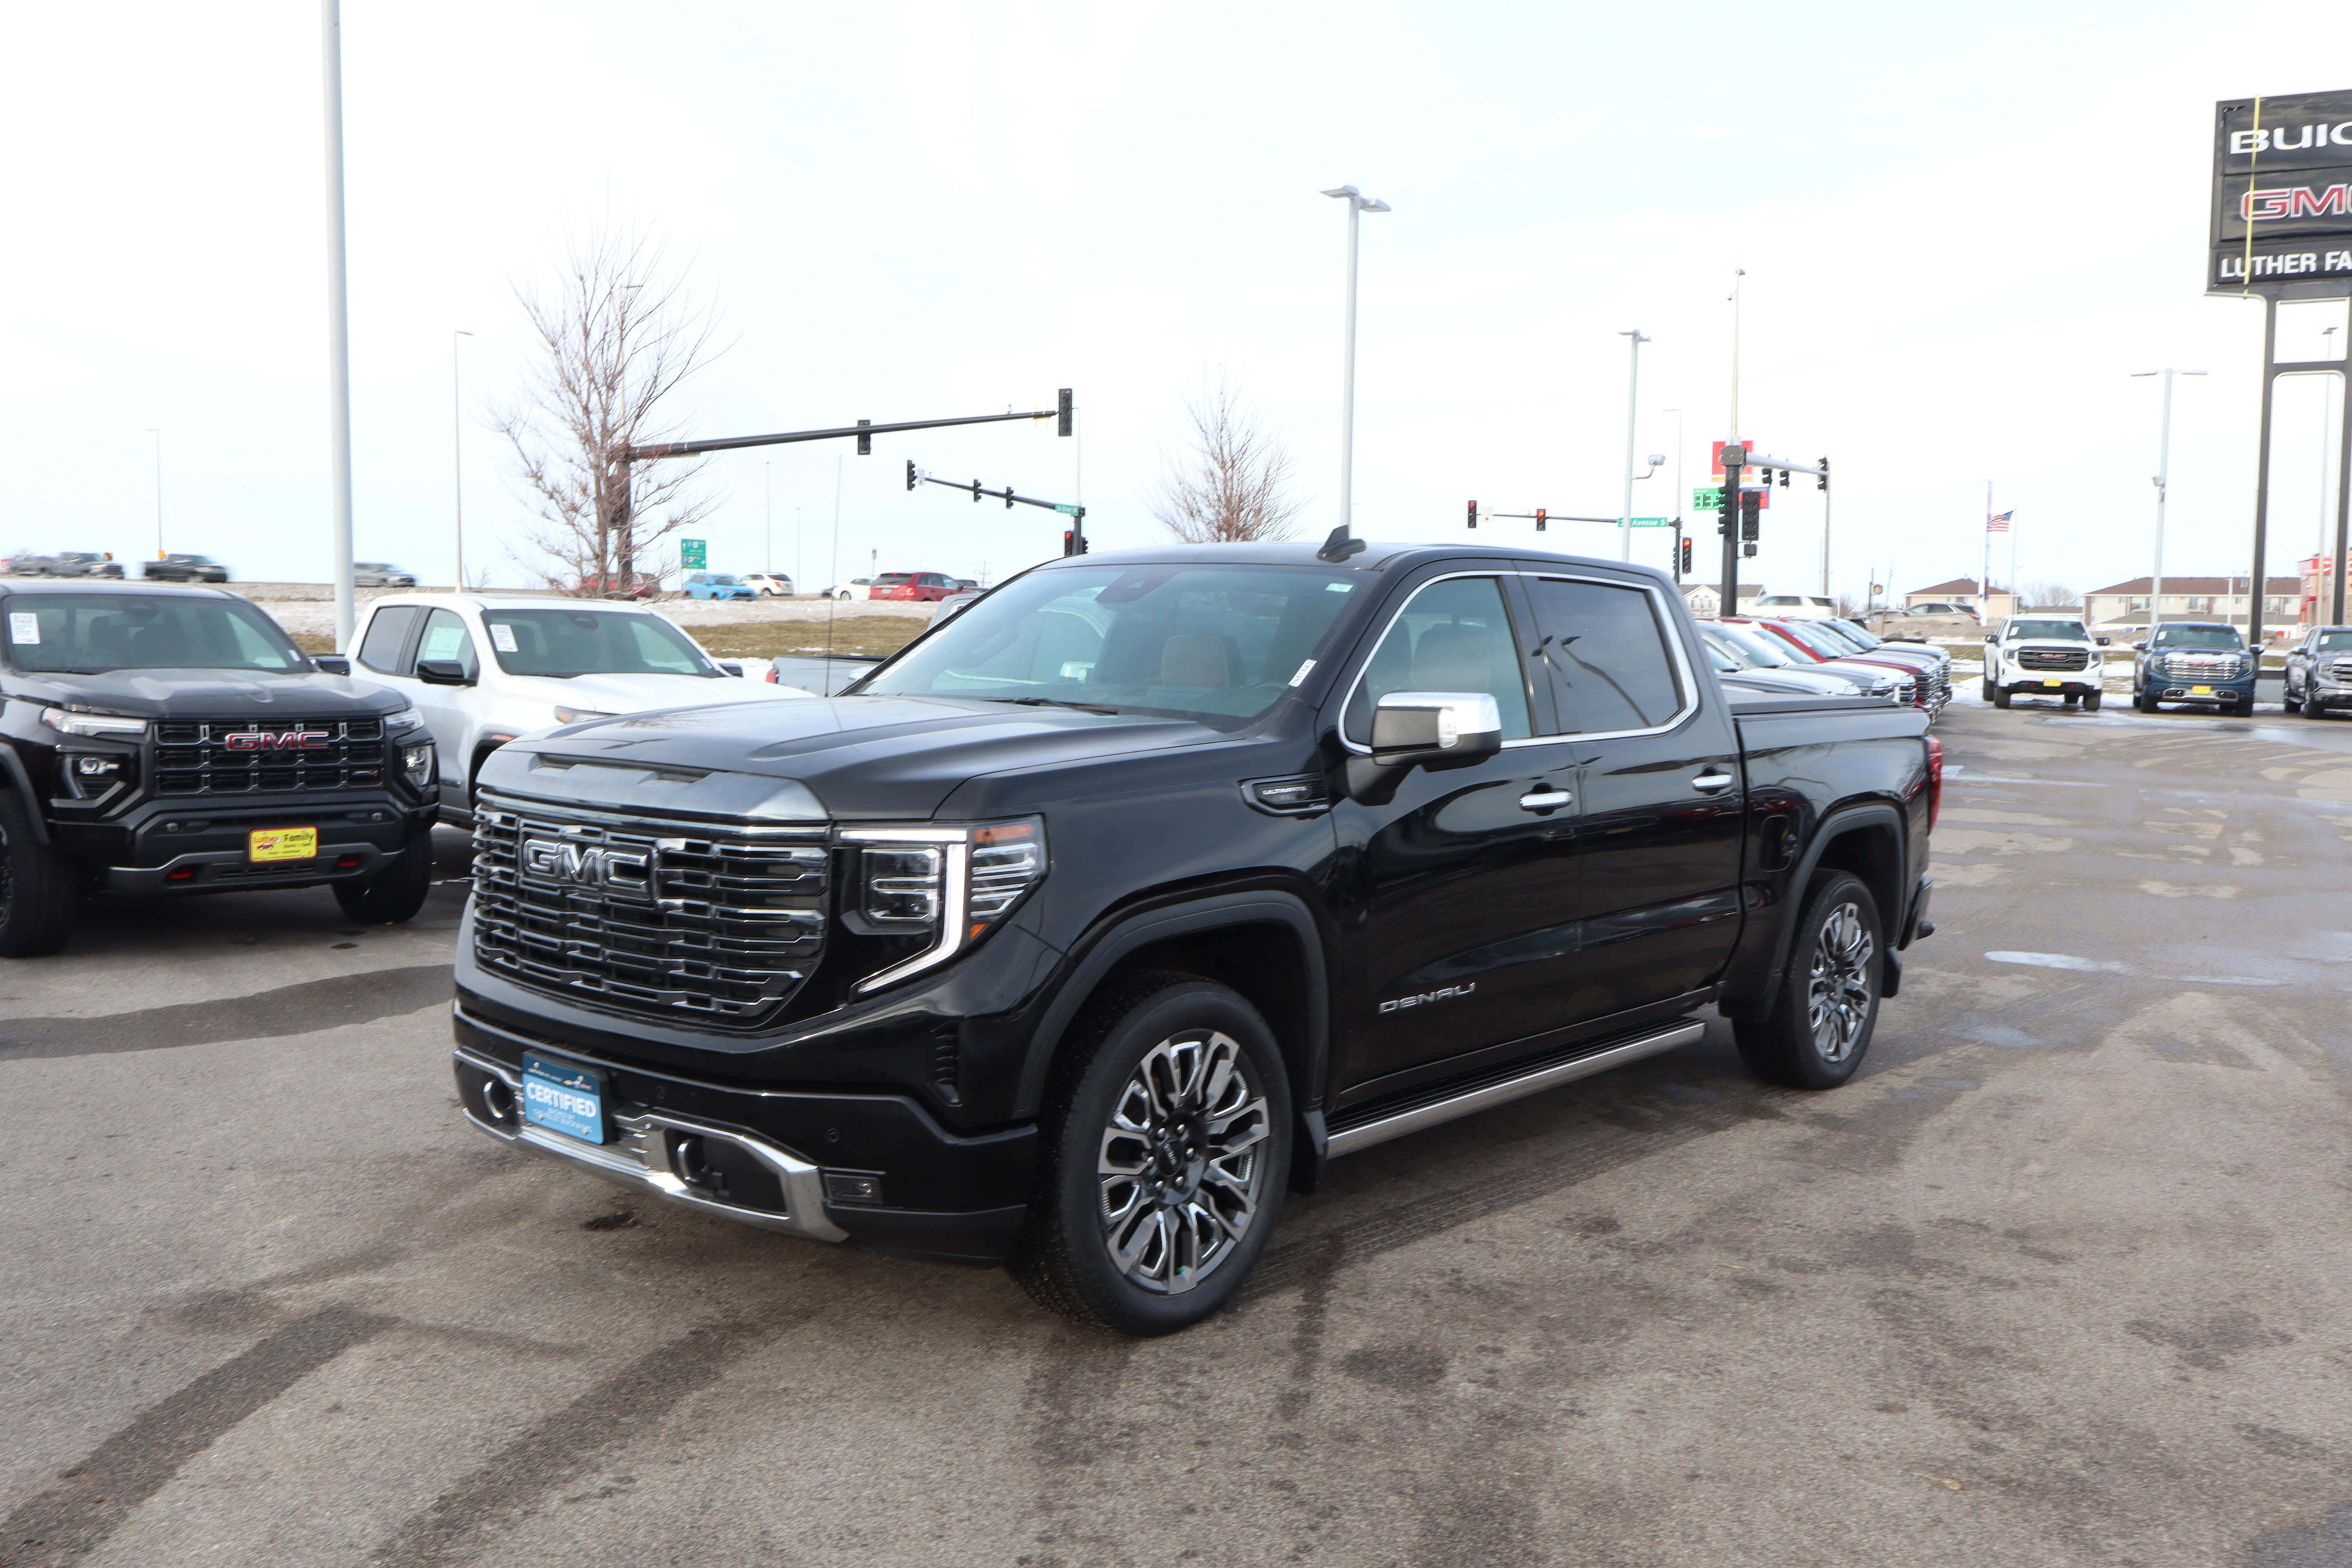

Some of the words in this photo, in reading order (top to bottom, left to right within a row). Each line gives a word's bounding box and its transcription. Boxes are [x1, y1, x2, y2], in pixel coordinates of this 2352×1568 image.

[2241, 183, 2352, 220] GM
[2221, 252, 2317, 278] LUTHER
[225, 731, 329, 751] GMC
[523, 839, 648, 893] GMC
[1379, 982, 1476, 1014] DENALI
[526, 1082, 597, 1118] CERTIFIED
